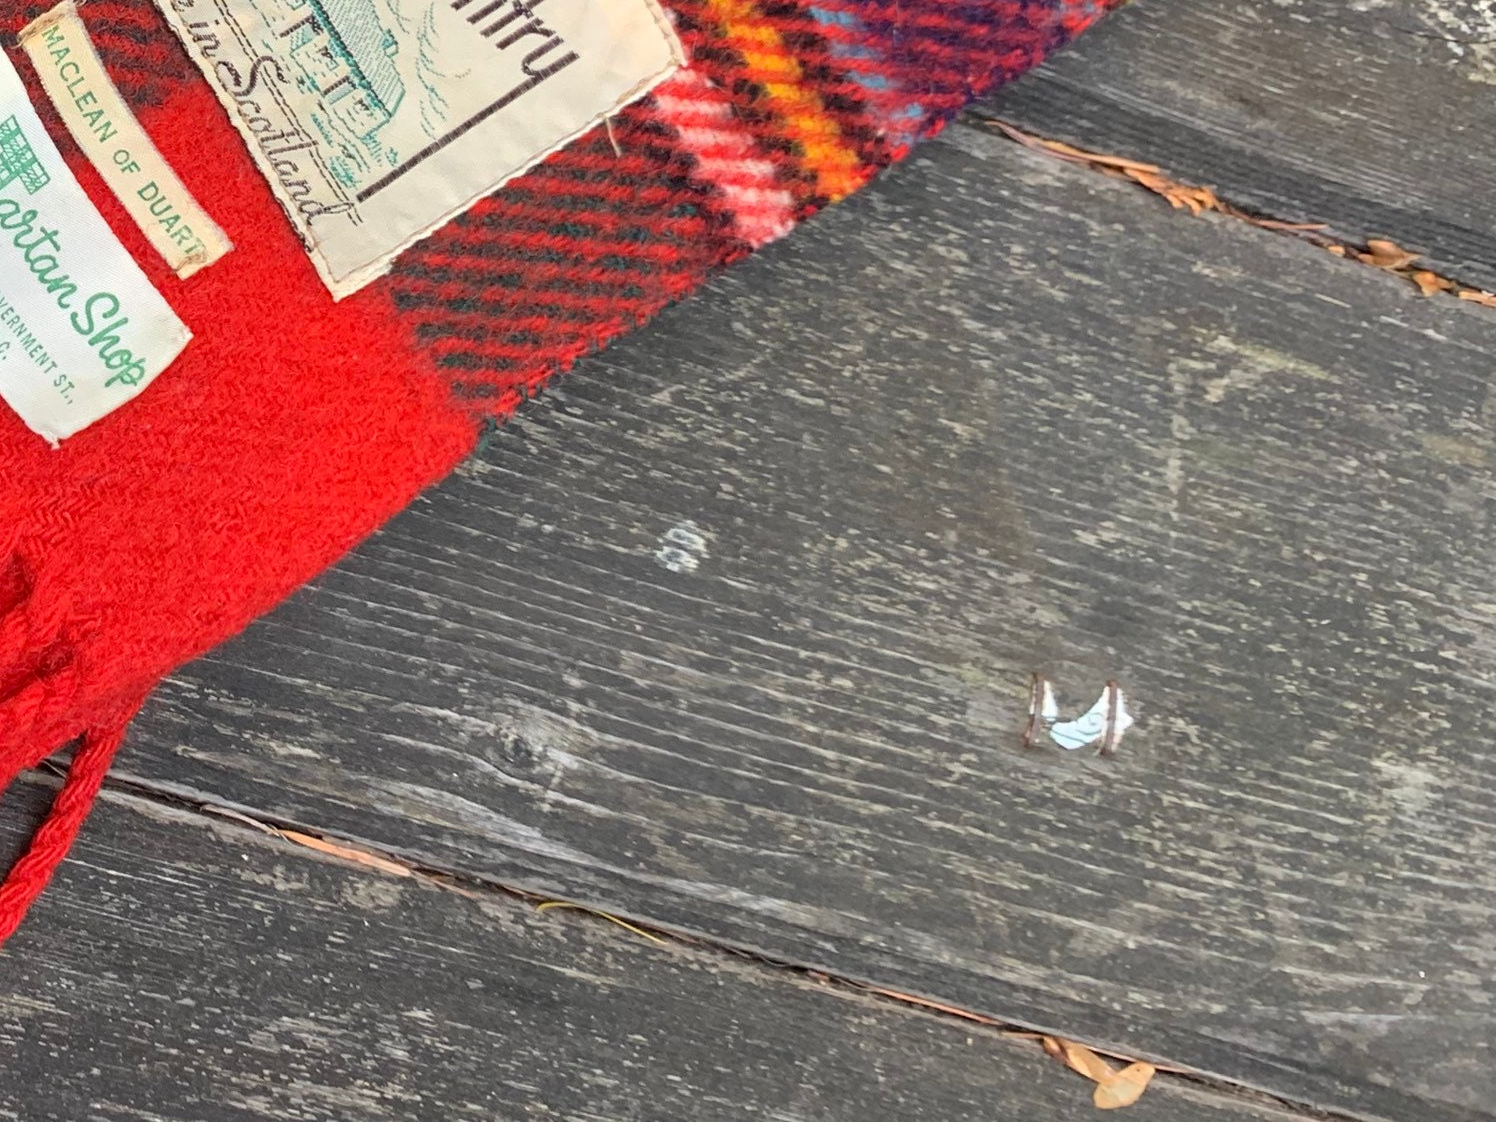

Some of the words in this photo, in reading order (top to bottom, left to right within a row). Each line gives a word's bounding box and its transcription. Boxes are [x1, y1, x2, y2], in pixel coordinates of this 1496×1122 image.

[41, 25, 118, 143] MACLEAN
[113, 149, 140, 175] OF
[137, 181, 203, 258] DUART
[189, 21, 220, 59] in
[215, 55, 352, 225] Scotland
[71, 292, 146, 389] Shop
